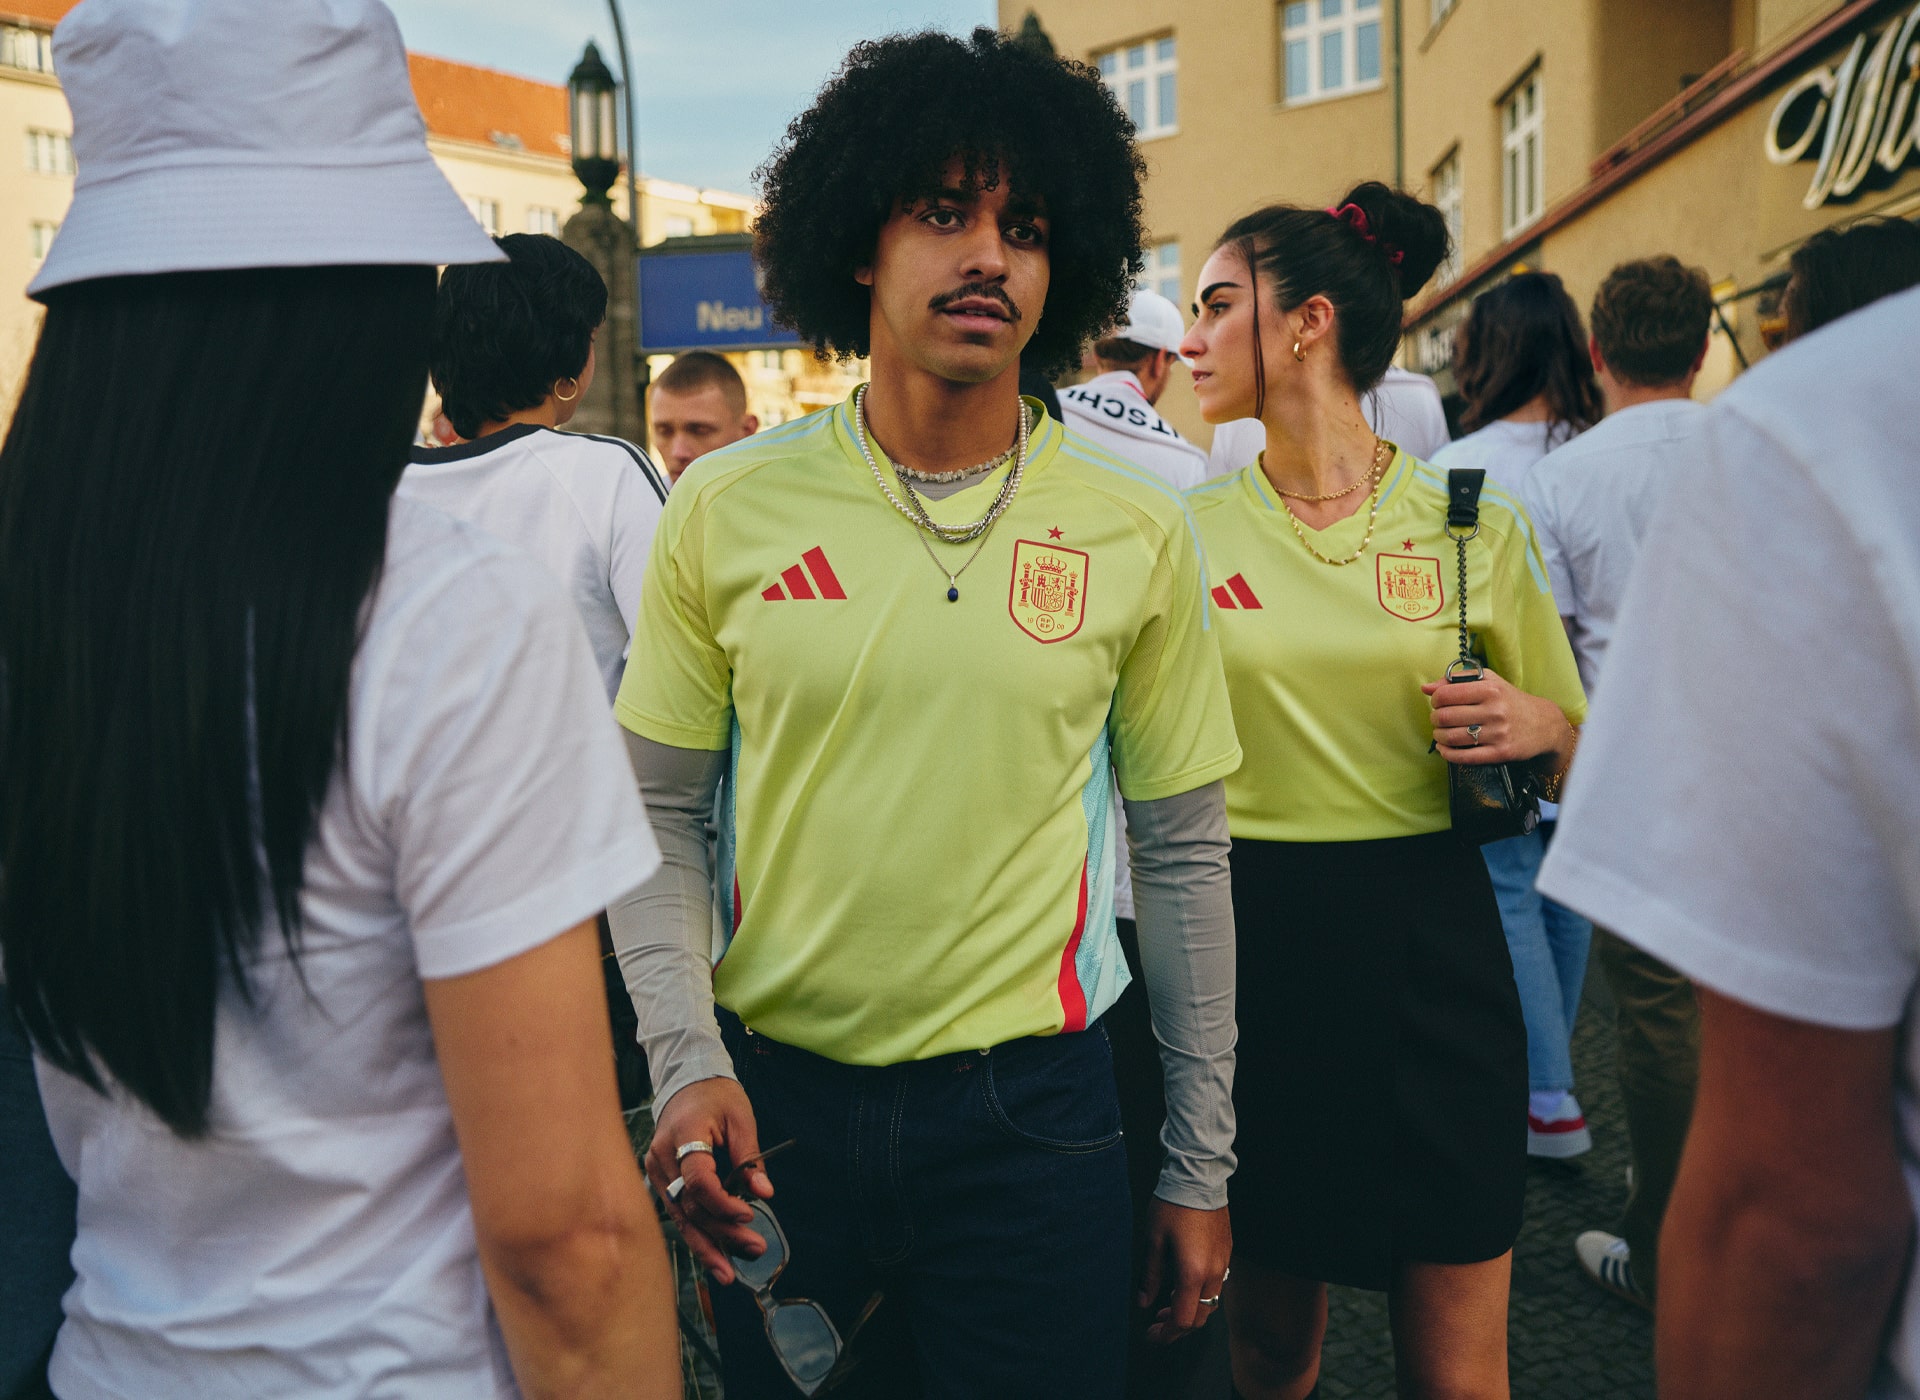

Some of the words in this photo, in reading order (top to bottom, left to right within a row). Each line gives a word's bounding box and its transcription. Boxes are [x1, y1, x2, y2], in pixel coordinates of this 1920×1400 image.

[1764, 4, 1920, 210] Wi
[696, 300, 763, 332] Neu
[1067, 389, 1179, 438] TSCH
